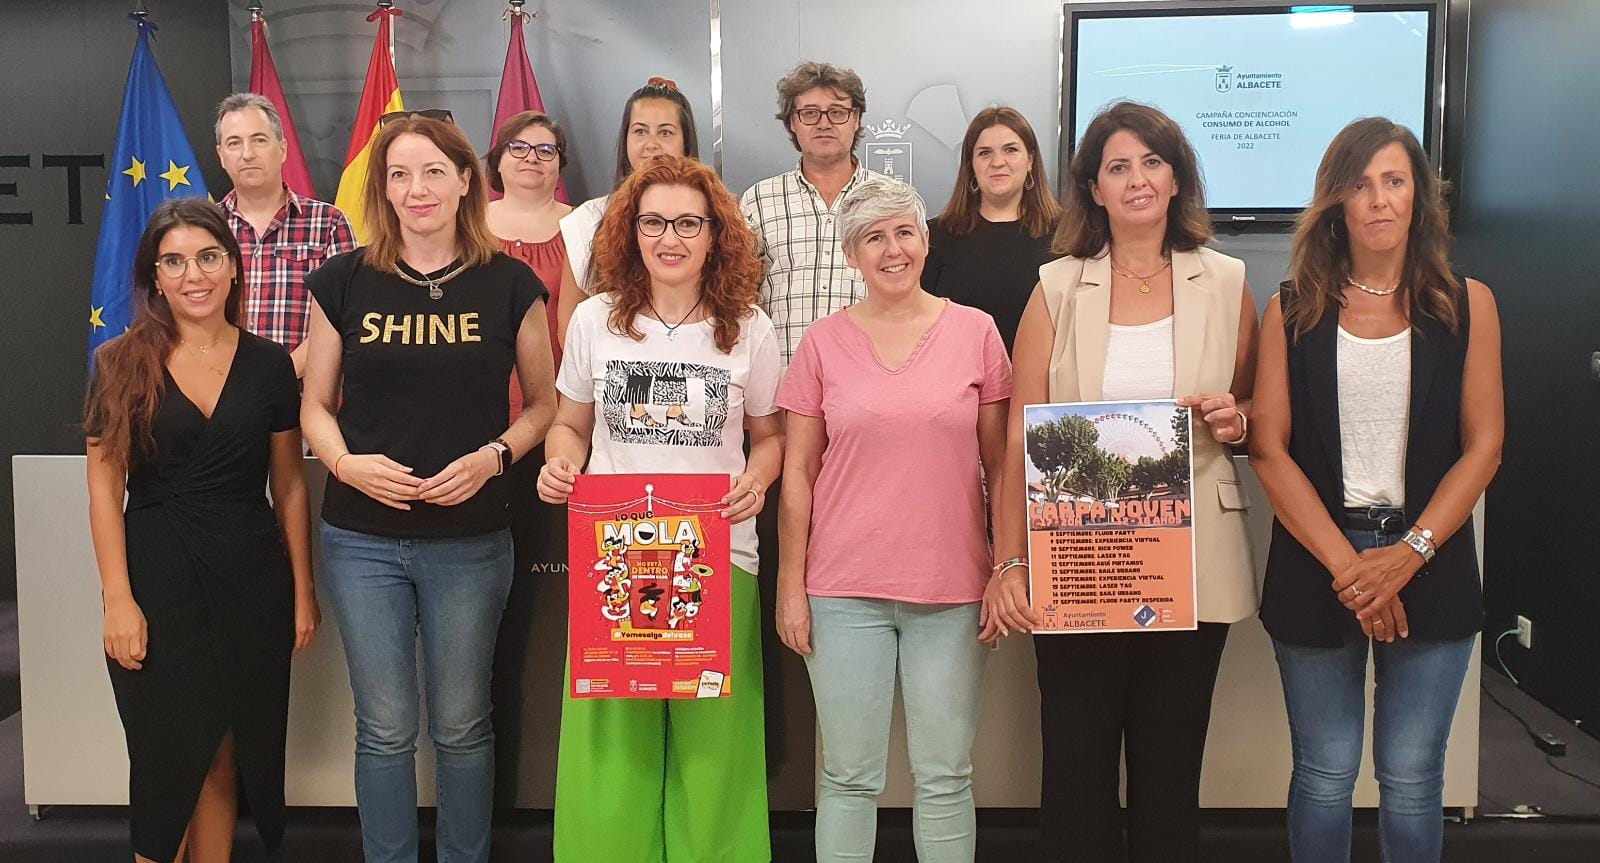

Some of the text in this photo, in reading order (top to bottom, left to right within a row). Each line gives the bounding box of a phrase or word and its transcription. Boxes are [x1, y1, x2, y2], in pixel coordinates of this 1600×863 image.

[1236, 81, 1281, 89] ALBACETE
[1196, 110, 1298, 119] CAMPAÑA CONCIENCIACIÓN
[1211, 133, 1231, 141] FERIA
[359, 312, 481, 345] SHINE
[1029, 499, 1191, 520] CARPA JOVEN
[615, 511, 654, 521] LO QUE
[602, 519, 701, 547] MOLA
[631, 566, 668, 575] DENTRO
[1063, 611, 1107, 619] Ayuntamiento
[1063, 619, 1108, 628] ALBACETE
